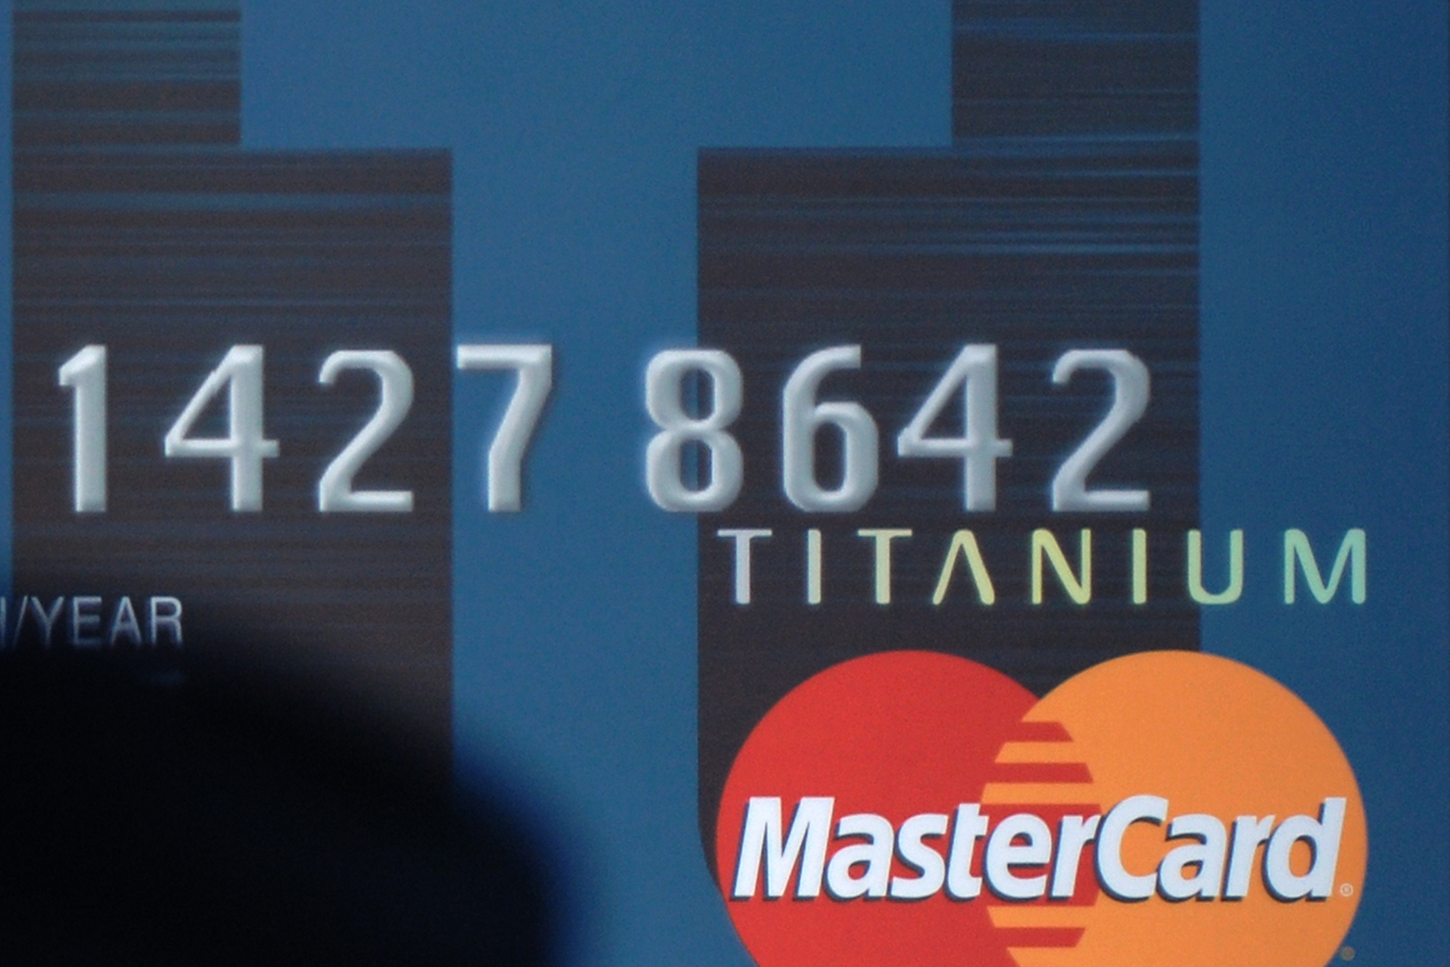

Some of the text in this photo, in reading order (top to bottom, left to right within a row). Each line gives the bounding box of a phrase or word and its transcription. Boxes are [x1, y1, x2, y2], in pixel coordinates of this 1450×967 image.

[57, 343, 554, 513] 1427
[643, 343, 1155, 514] 8642
[715, 527, 1369, 607] TITANIUM
[728, 793, 1349, 904] MasterCard
